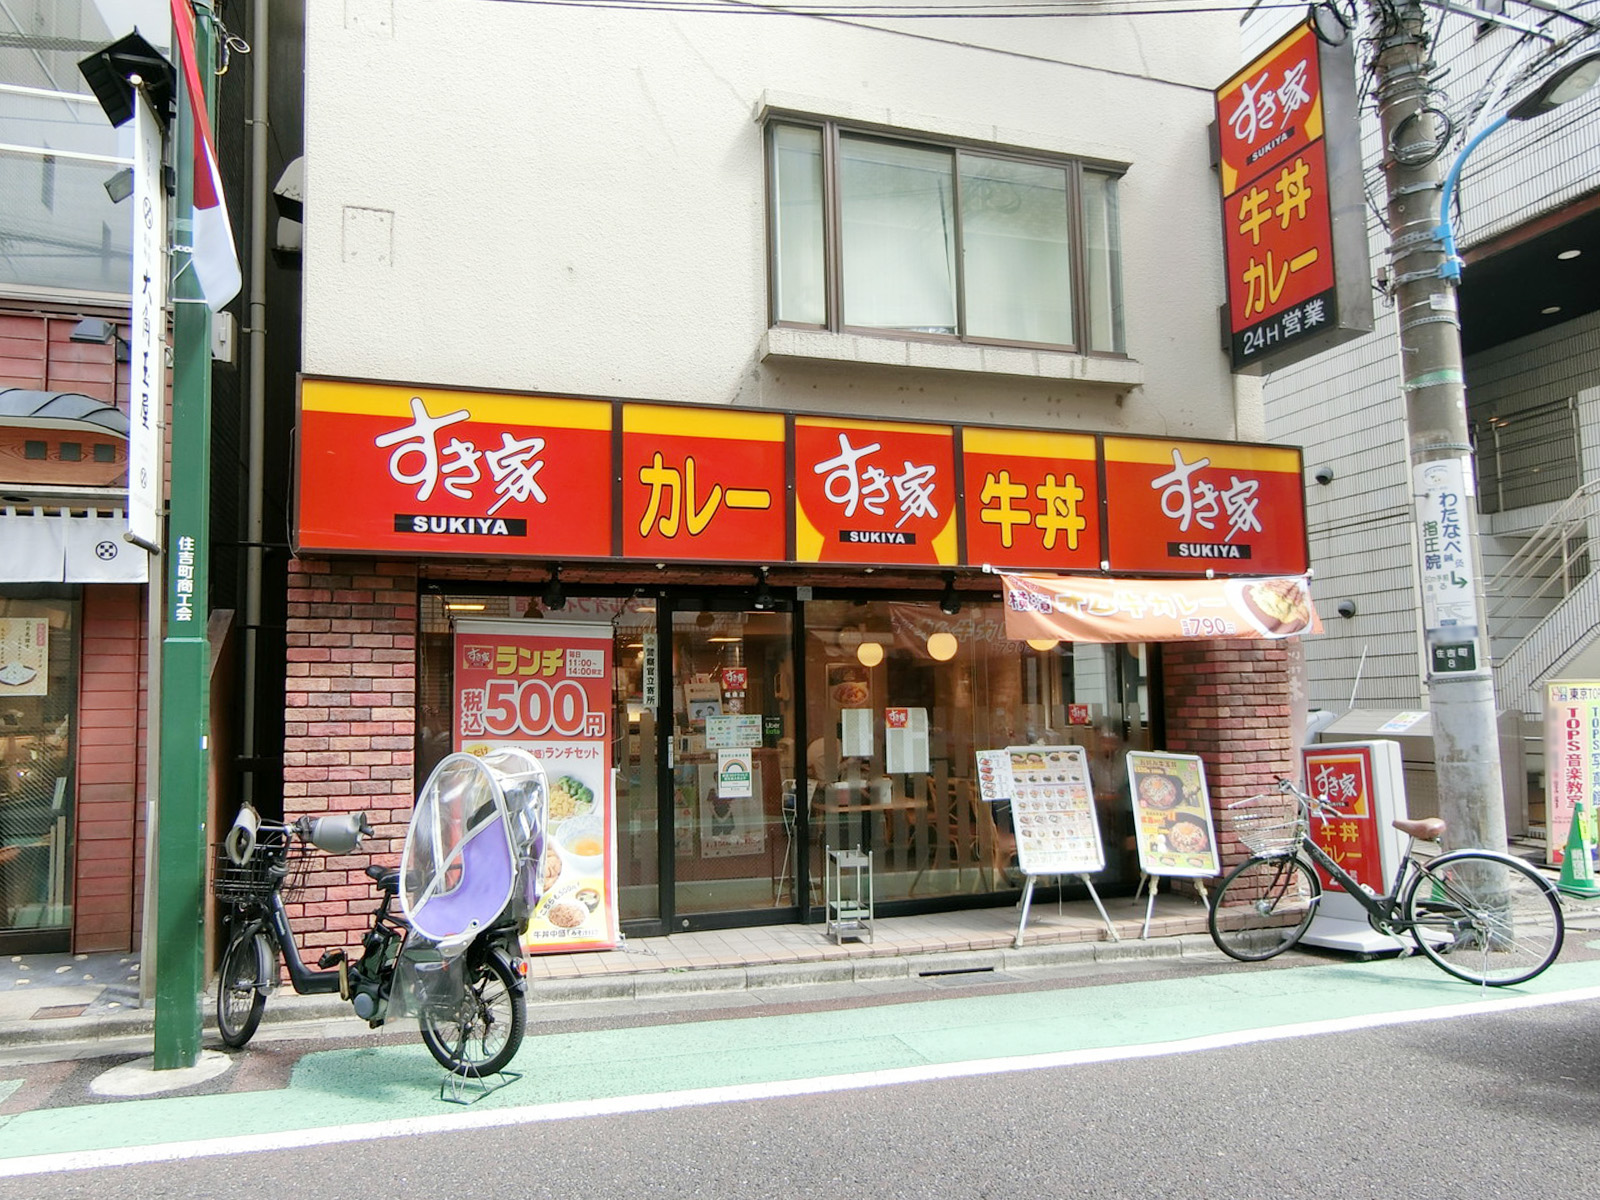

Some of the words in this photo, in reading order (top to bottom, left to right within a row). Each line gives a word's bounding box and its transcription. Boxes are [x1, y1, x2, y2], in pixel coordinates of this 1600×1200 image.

[1228, 59, 1310, 144] すき家
[1251, 132, 1289, 161] SUKIYA
[1239, 157, 1312, 245] 牛丼
[1243, 247, 1319, 319] カレー
[375, 396, 548, 516] すき家
[813, 433, 939, 528] すき家
[639, 451, 771, 538] カレー
[980, 469, 1087, 550] 牛丼
[1151, 448, 1263, 542] すき家
[413, 516, 509, 536] SUKIYA
[849, 531, 906, 544] SUKIYA
[1179, 543, 1240, 558] SUKIYA
[1422, 519, 1442, 571] 指圧院
[176, 536, 195, 622] 住吉町商工会
[496, 646, 564, 677] ランチ
[463, 690, 483, 733] 税込
[1314, 764, 1358, 801] すき家
[1320, 821, 1360, 843] 牛丼
